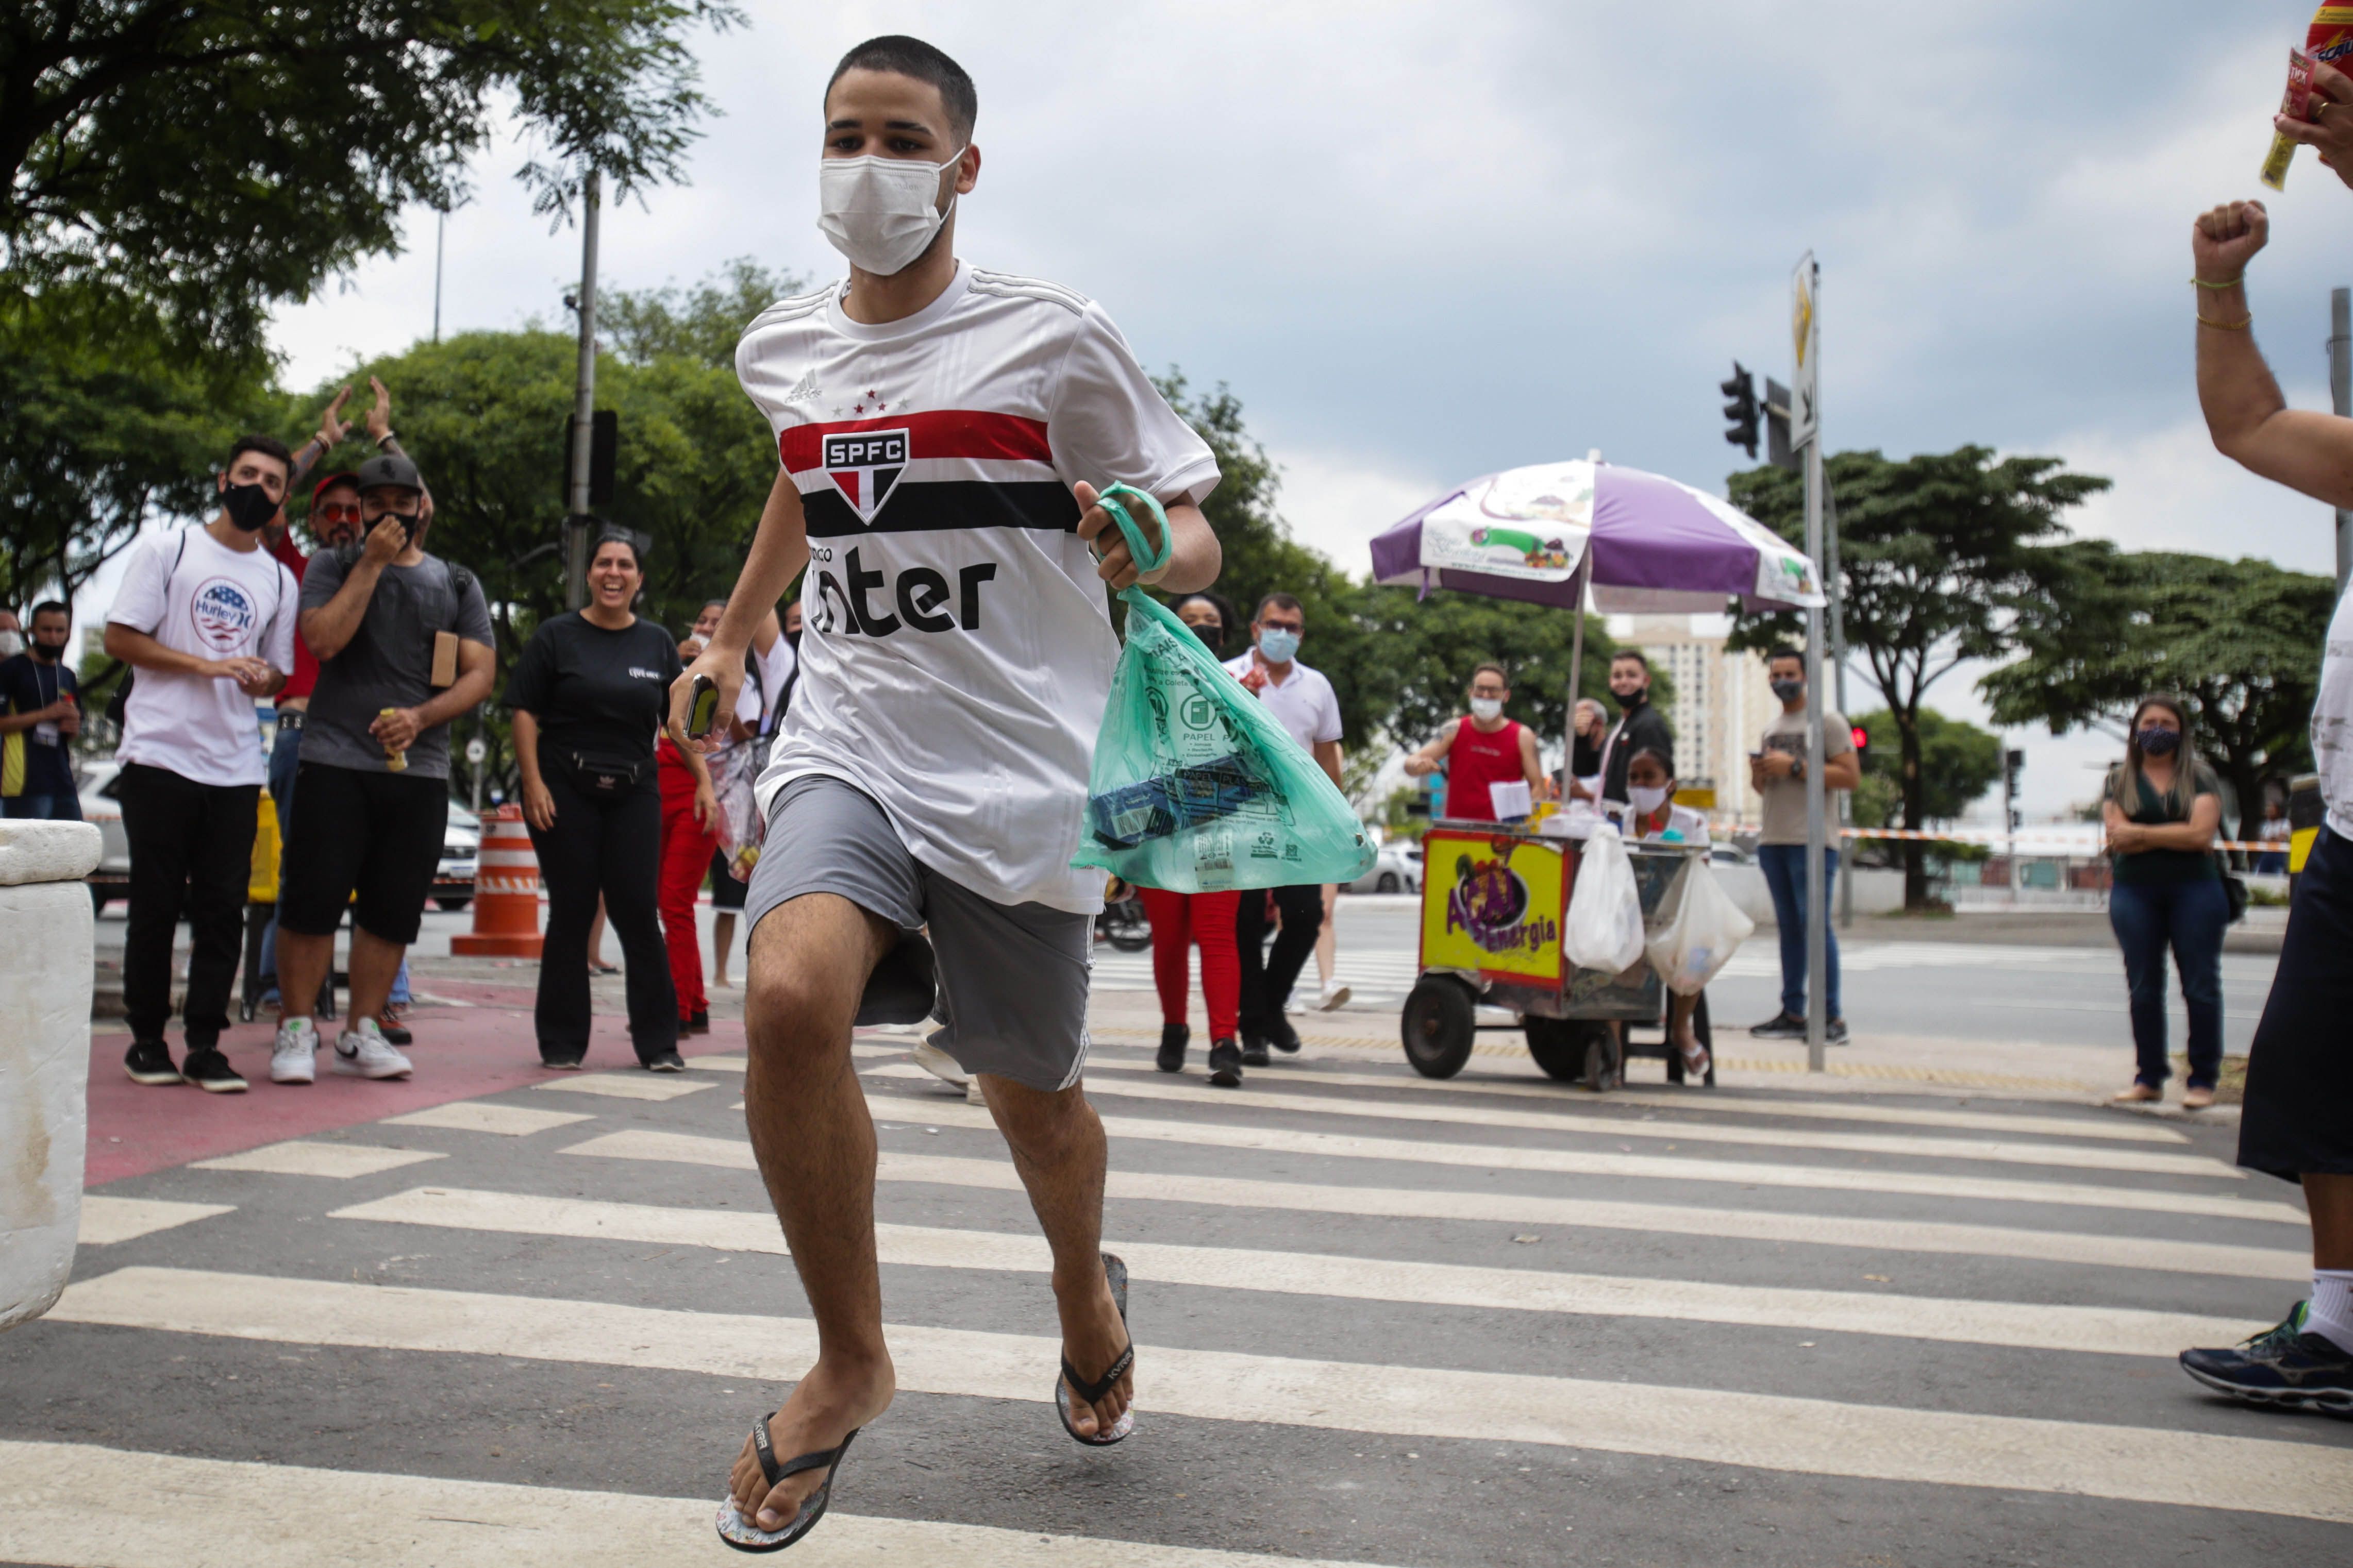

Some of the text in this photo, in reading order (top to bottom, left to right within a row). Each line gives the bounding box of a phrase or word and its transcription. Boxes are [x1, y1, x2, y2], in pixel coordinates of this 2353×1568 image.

[830, 440, 902, 464] SPFC
[811, 546, 997, 637] nter
[195, 599, 237, 622] Hurley
[1183, 733, 1215, 741] PAPEL
[1183, 771, 1212, 782] PAPEL
